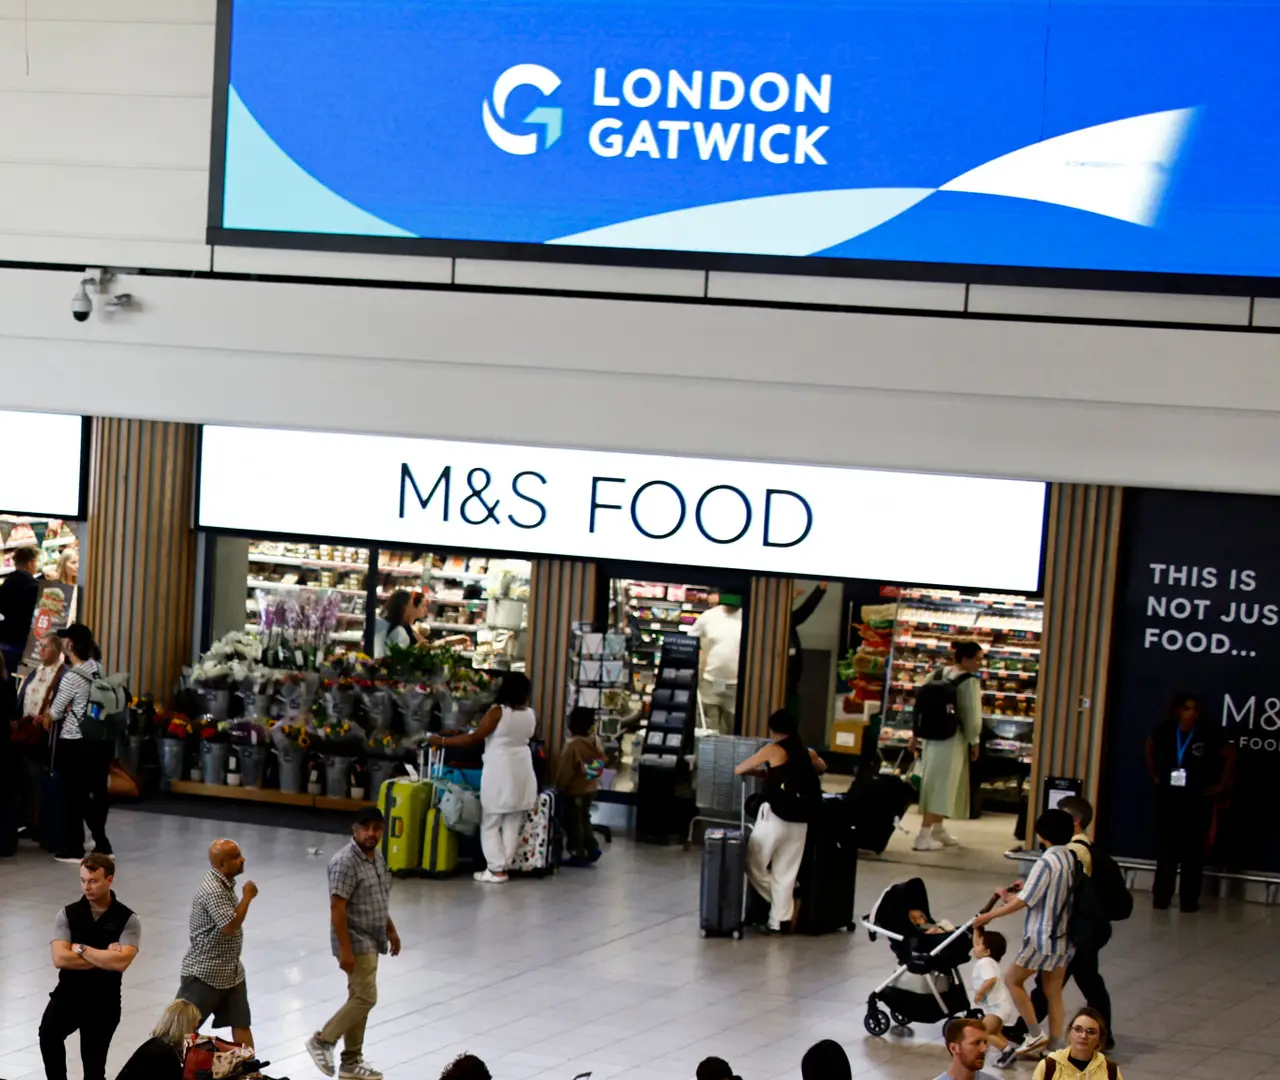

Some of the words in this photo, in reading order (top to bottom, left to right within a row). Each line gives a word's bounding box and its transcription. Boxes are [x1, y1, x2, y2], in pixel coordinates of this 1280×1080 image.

[593, 67, 832, 114] LONDON
[589, 117, 830, 165] GATWICK
[399, 462, 547, 529] M&S
[589, 476, 813, 548] FOOD
[1149, 563, 1218, 588] THIS
[1229, 567, 1257, 592] IS
[1146, 595, 1211, 620] NOT
[1143, 628, 1257, 658] FOOD...
[1239, 736, 1280, 752] FOO
